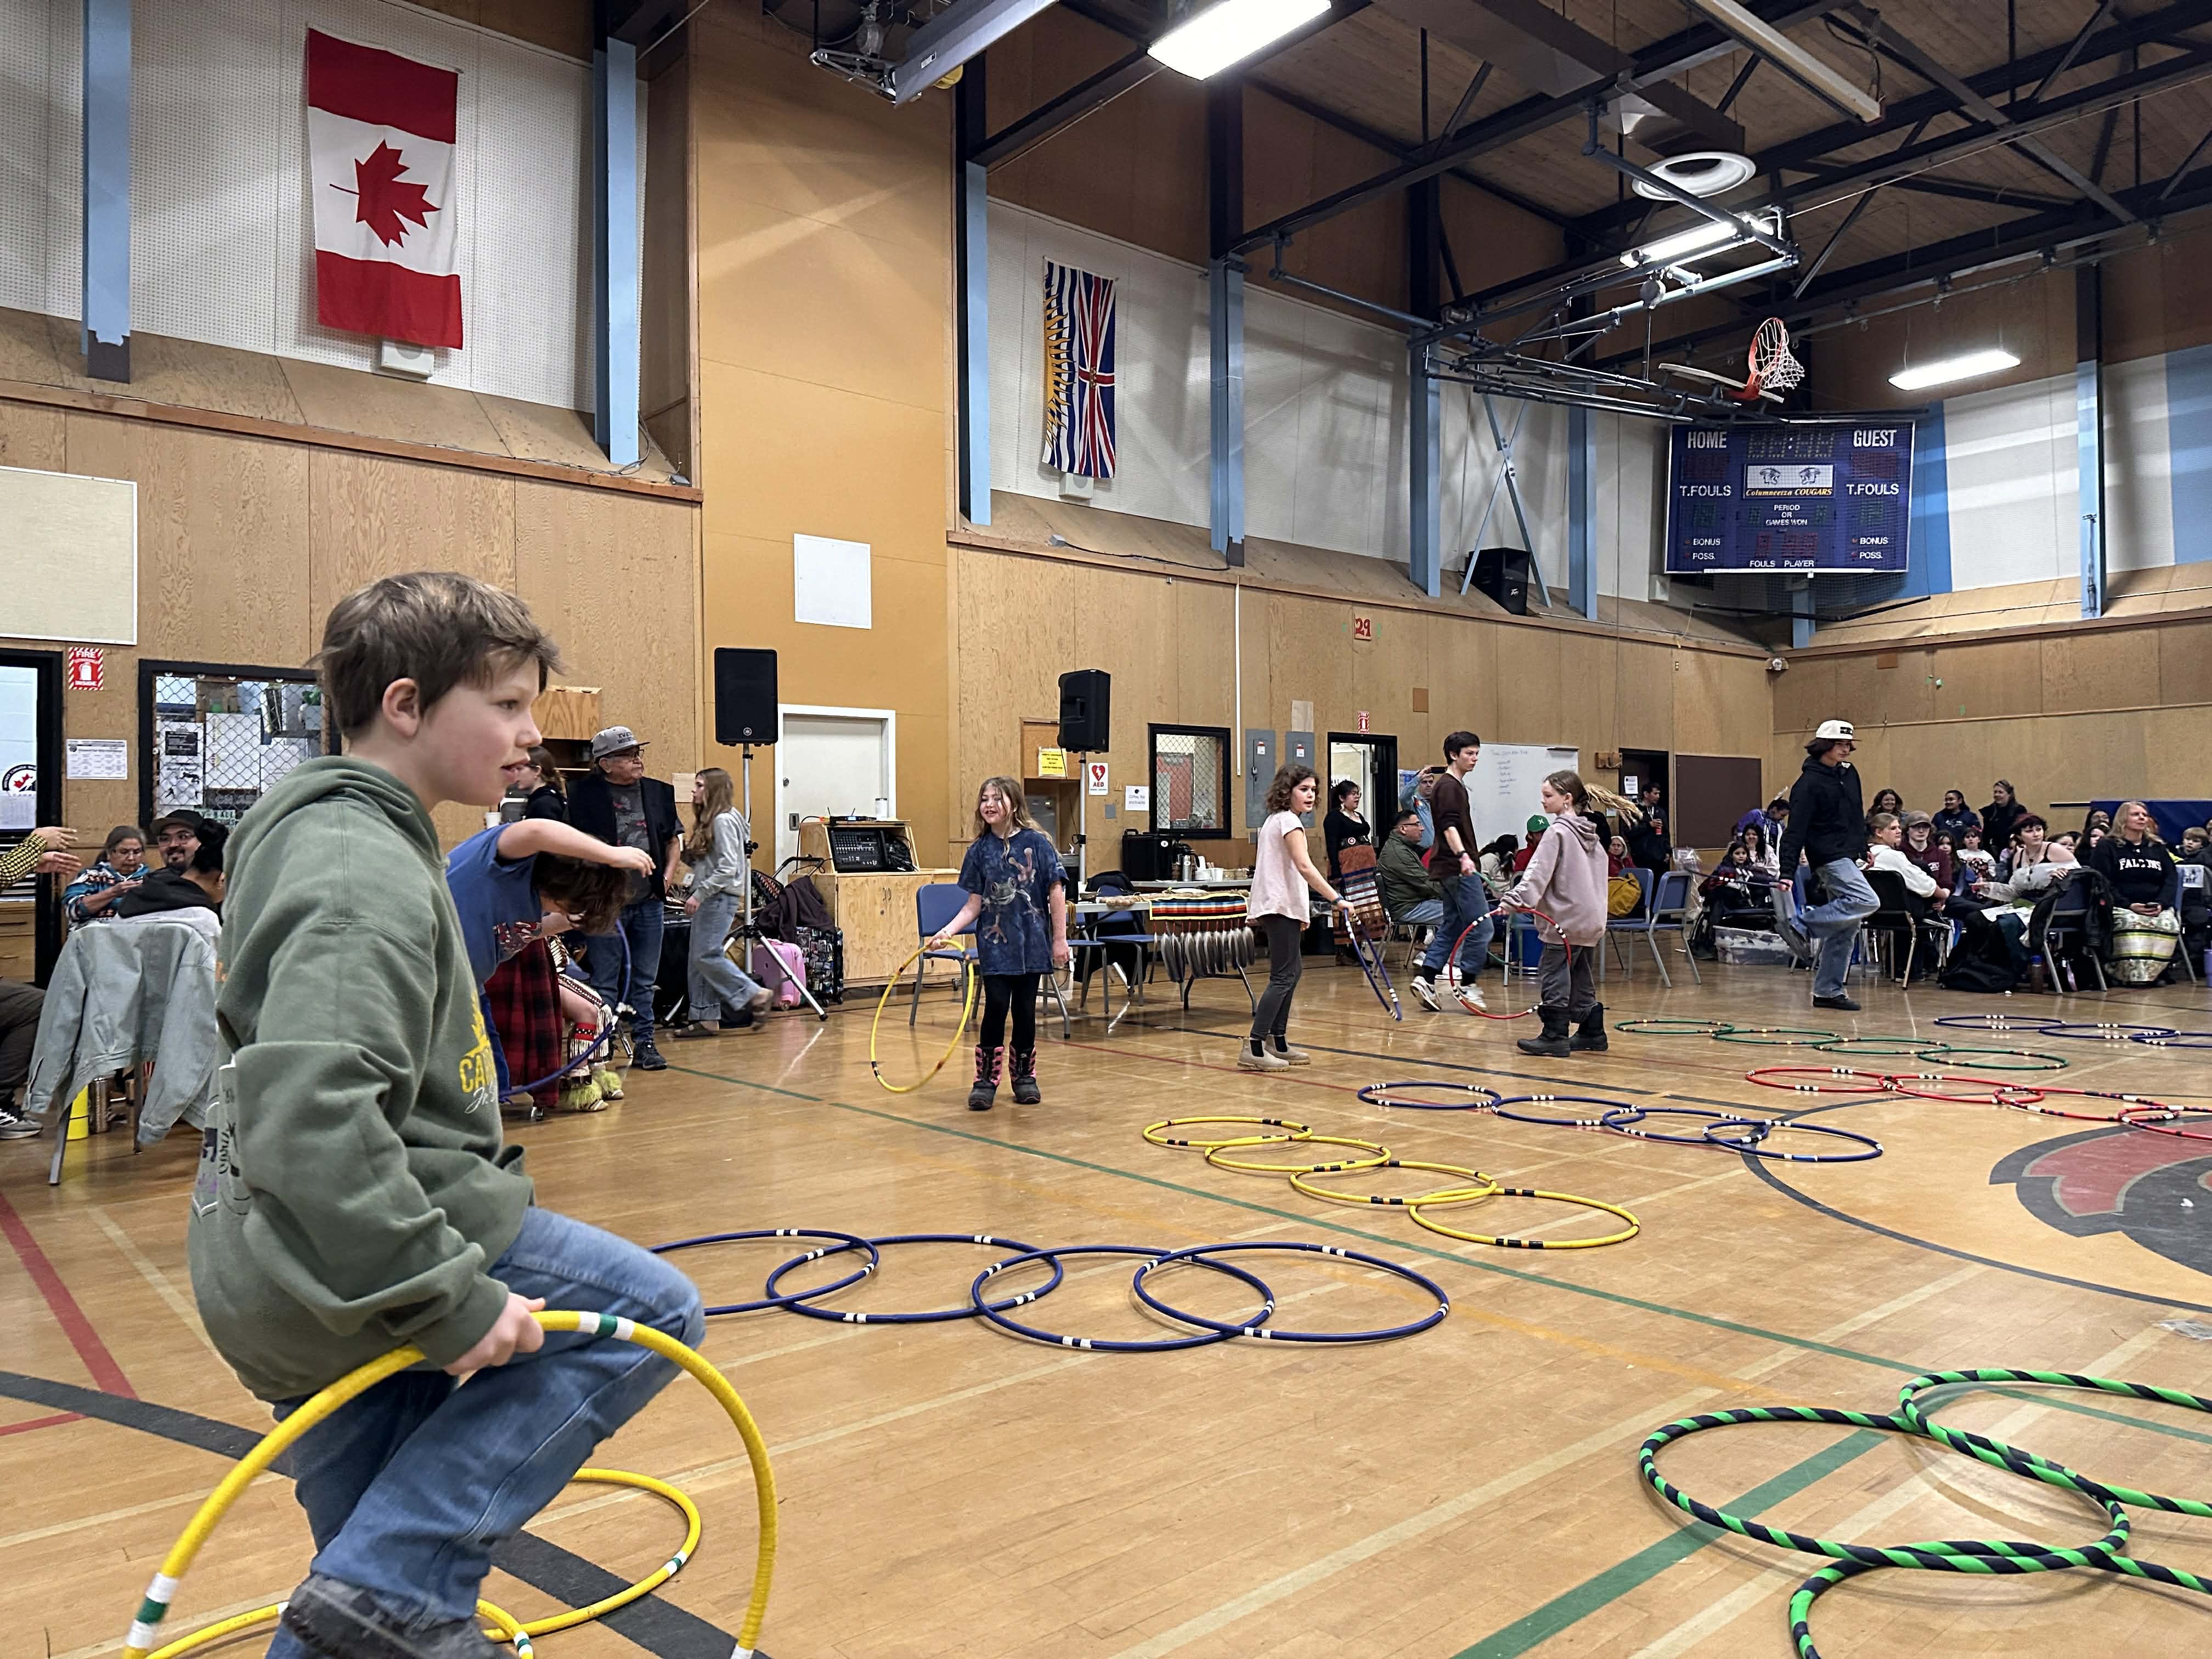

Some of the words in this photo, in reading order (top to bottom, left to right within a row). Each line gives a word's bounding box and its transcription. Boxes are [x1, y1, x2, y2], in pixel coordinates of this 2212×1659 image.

[1688, 431, 1727, 449] HOME
[1853, 430, 1897, 447] GUEST
[1679, 485, 1731, 496] T.FOULS
[1846, 483, 1899, 495] T.FOULS
[1355, 618, 1371, 637] 29
